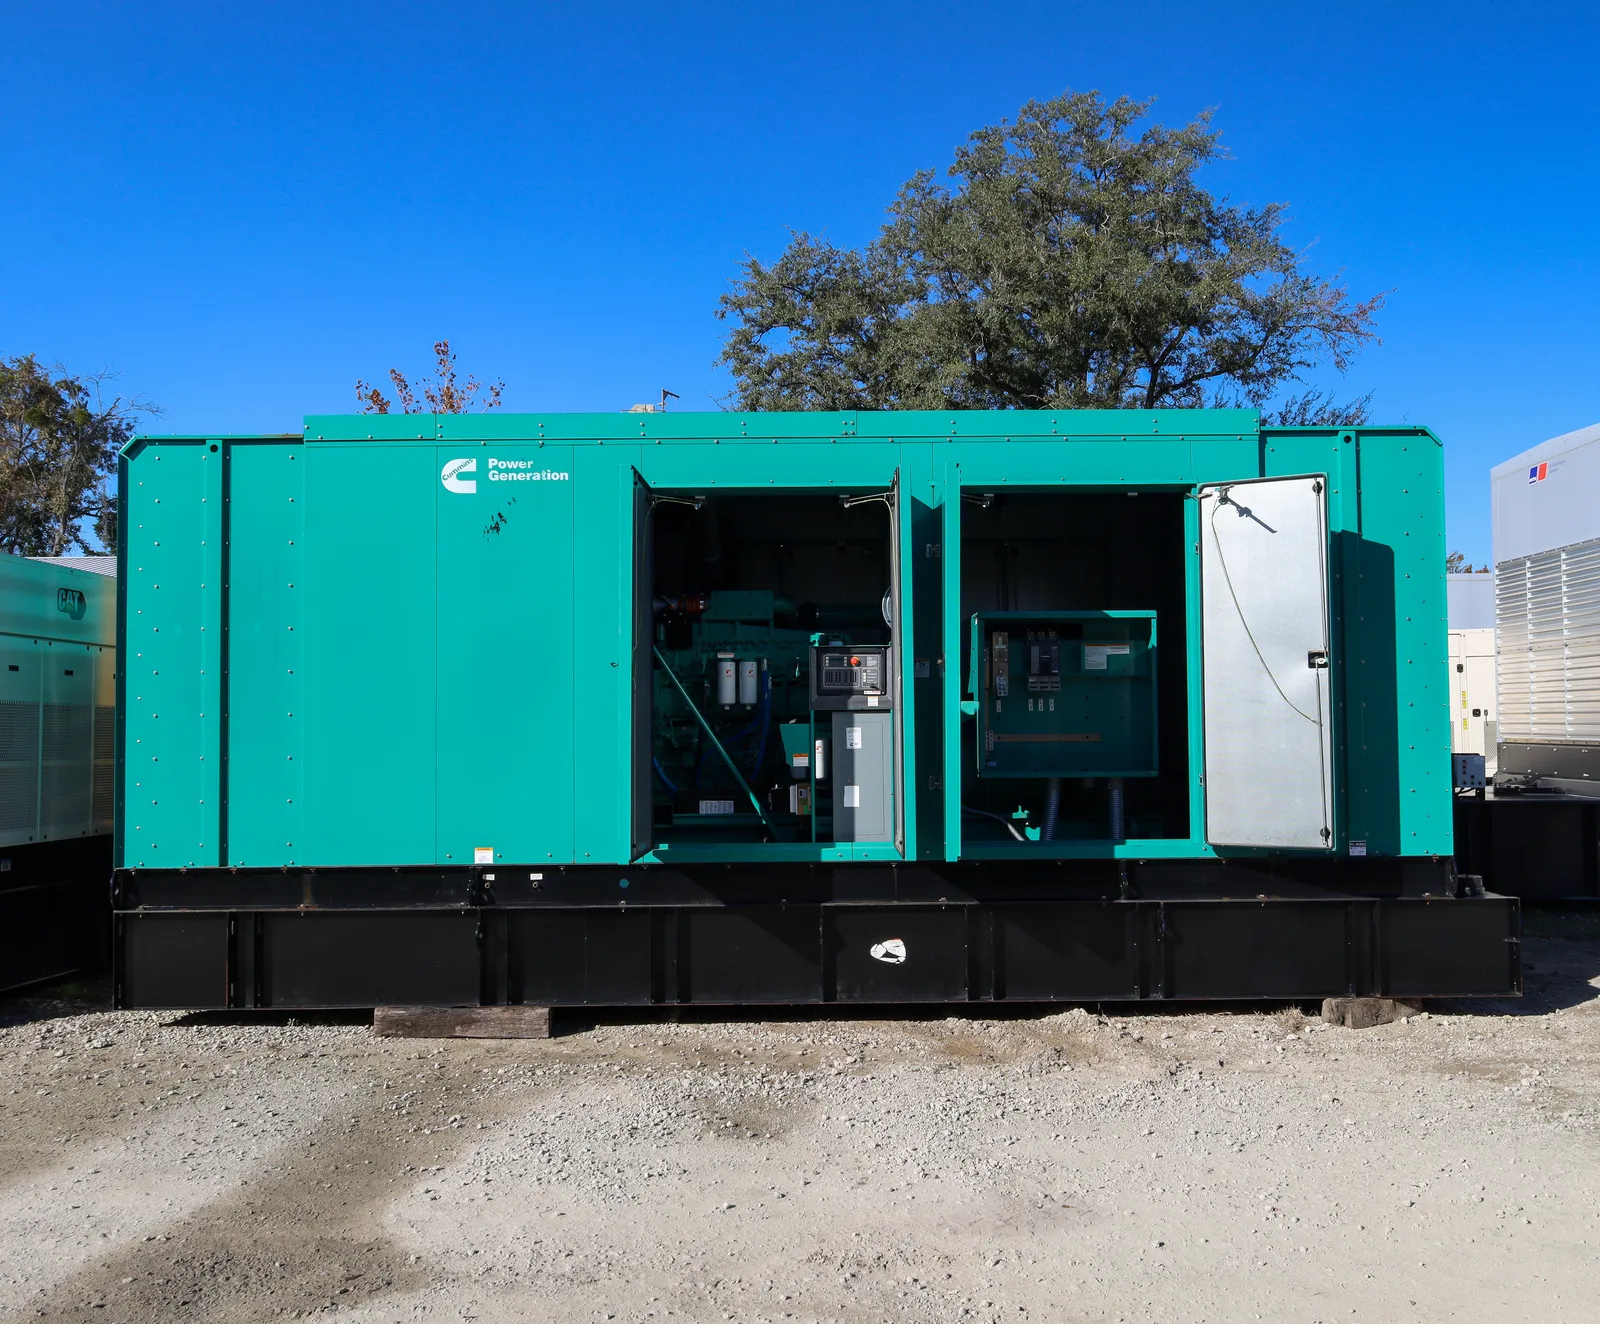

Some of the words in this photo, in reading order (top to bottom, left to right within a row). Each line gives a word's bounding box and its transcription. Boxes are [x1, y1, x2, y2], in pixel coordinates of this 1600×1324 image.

[442, 459, 474, 481] Cummins
[488, 458, 533, 469] Power
[488, 470, 569, 481] Generation
[59, 589, 80, 612] CAT
